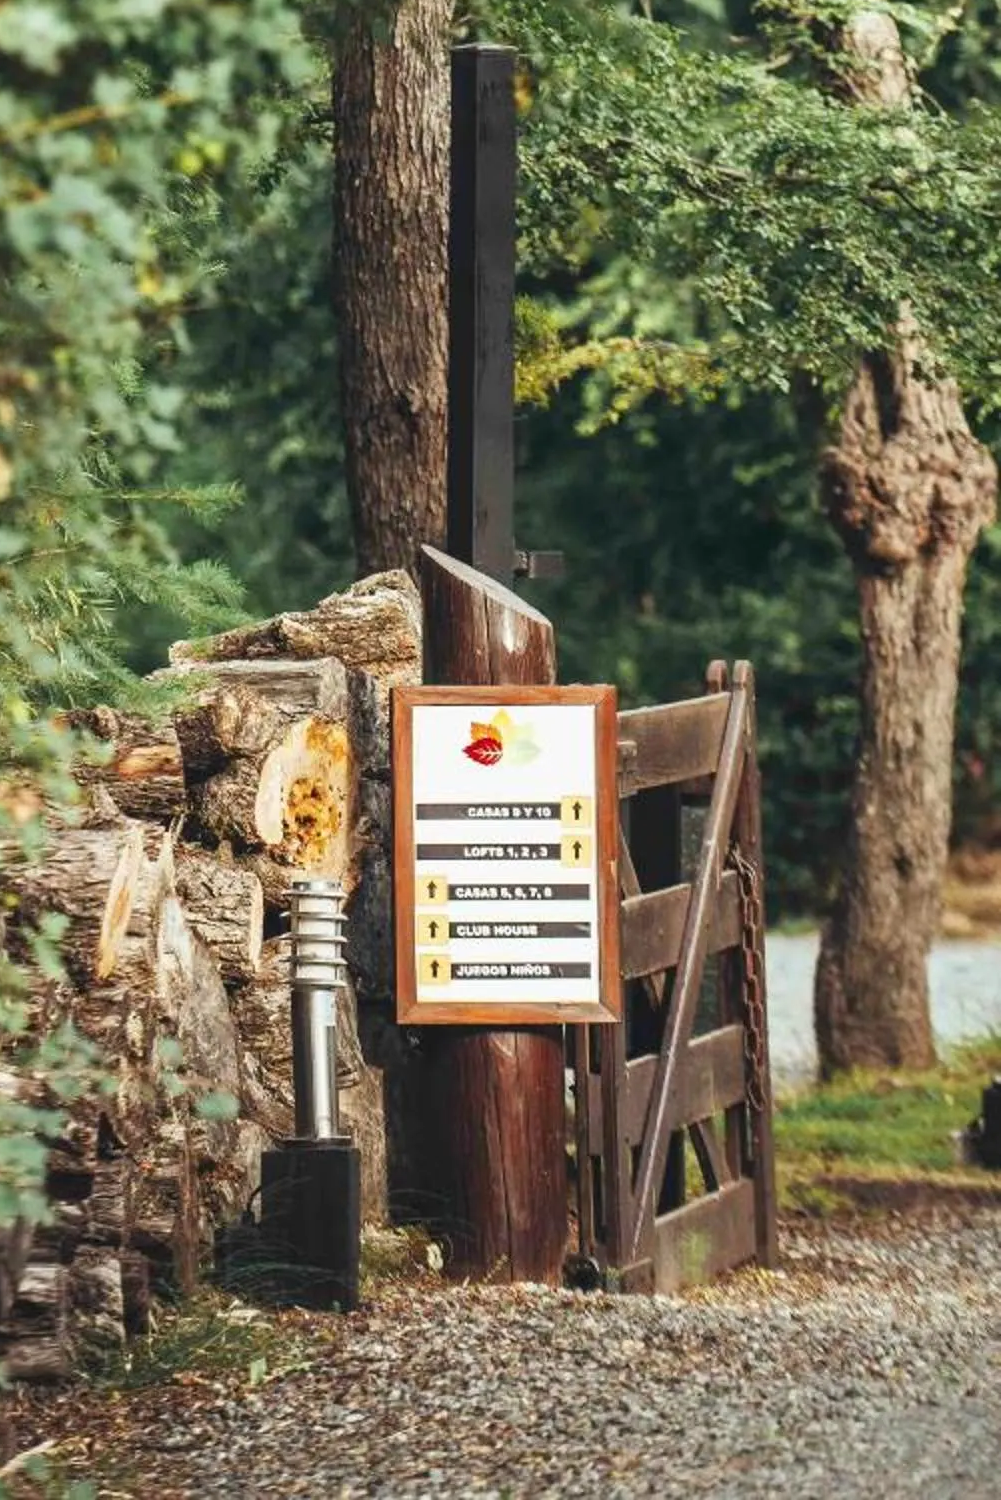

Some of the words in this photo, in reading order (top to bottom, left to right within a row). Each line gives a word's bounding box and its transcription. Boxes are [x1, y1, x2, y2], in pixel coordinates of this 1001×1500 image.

[468, 807, 509, 817] CASAS
[525, 807, 532, 816] Y
[536, 807, 551, 817] 10
[463, 847, 503, 857] LOFTS
[540, 847, 547, 857] 3
[455, 887, 497, 898] CASAS
[456, 925, 490, 936] CLUB
[494, 925, 538, 936] HOUSE
[456, 965, 507, 976] JUEGOS
[510, 964, 551, 976] NIÑOS
